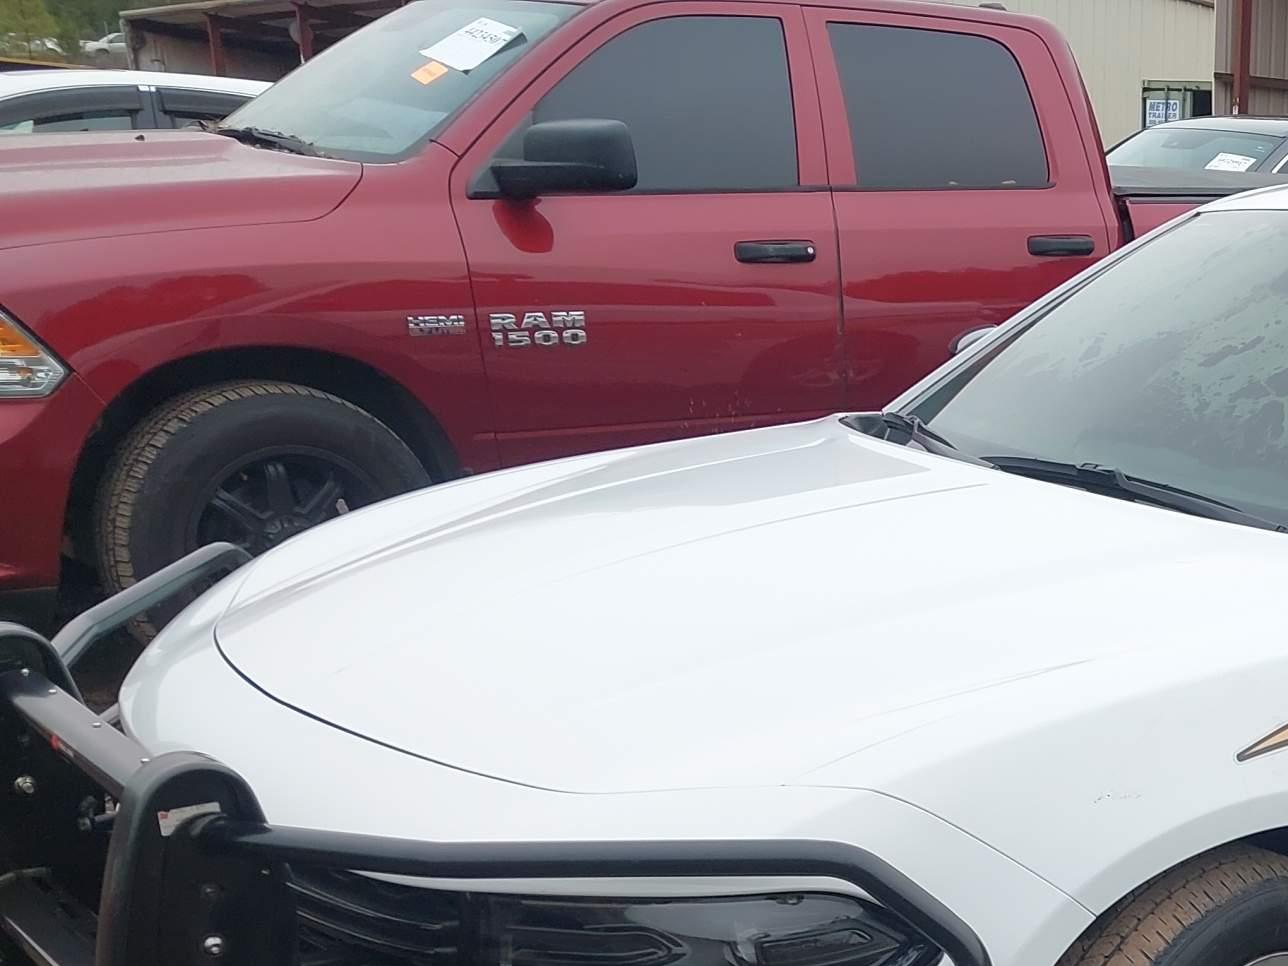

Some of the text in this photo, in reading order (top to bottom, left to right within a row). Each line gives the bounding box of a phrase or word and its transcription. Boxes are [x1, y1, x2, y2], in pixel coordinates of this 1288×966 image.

[1148, 101, 1178, 112] METRO
[407, 315, 465, 327] HEMI
[489, 311, 585, 330] RAM
[491, 329, 587, 346] 1500
